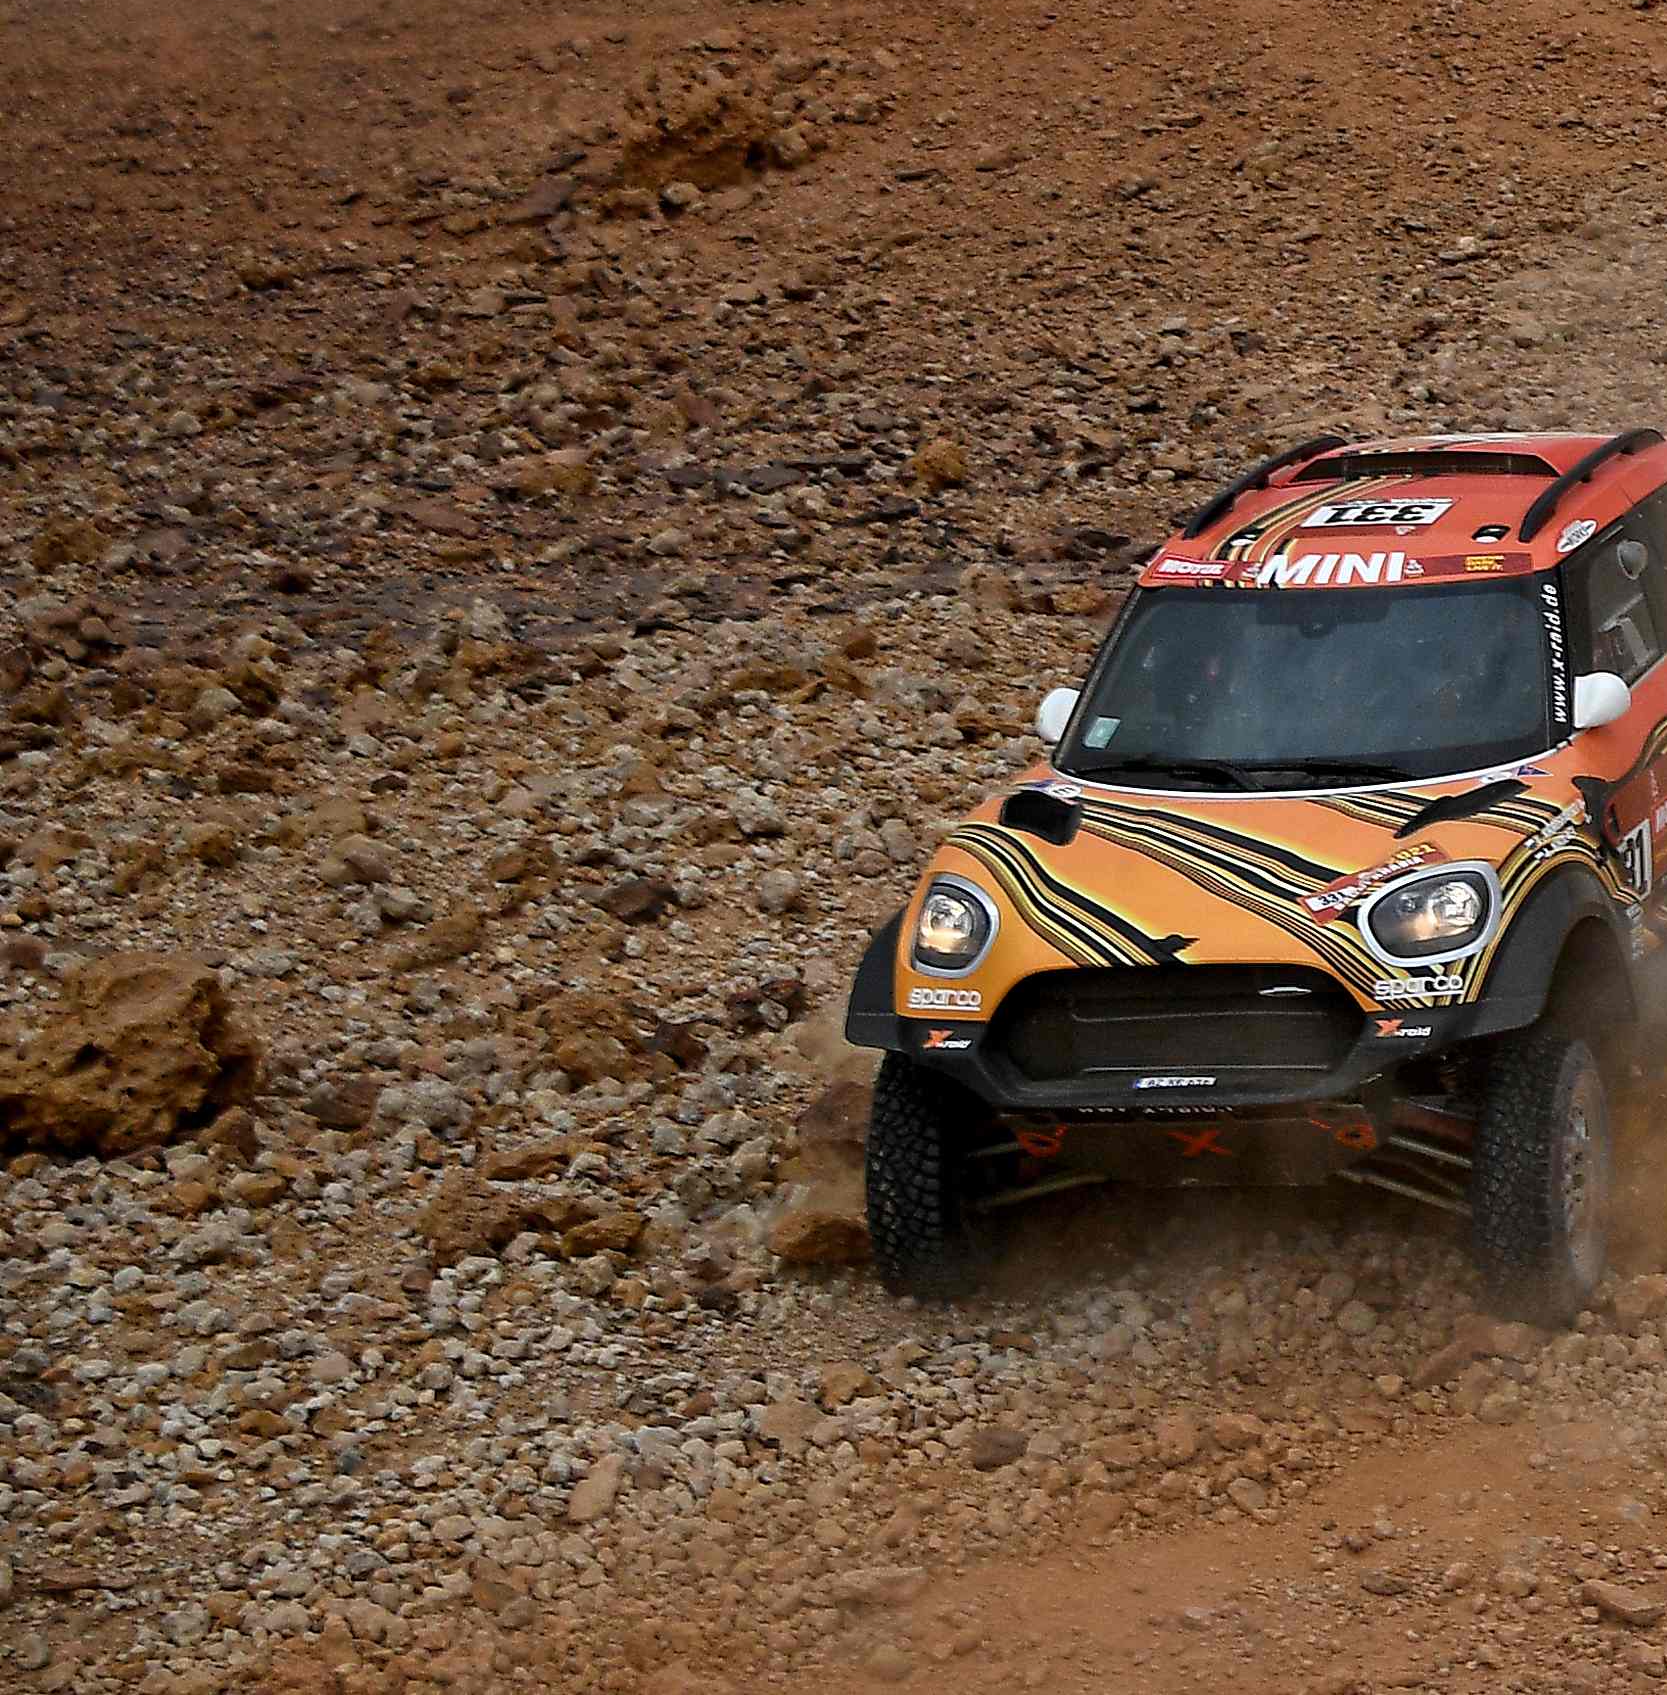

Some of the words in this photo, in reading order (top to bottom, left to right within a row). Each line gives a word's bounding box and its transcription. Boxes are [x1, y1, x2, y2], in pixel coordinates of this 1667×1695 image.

[1323, 504, 1435, 524] 331
[1157, 559, 1226, 575] MOTUL
[1258, 552, 1407, 585] MINI
[1540, 583, 1568, 724] www.x-raid.de
[907, 987, 983, 1011] sparco
[1374, 975, 1464, 1001] sparco
